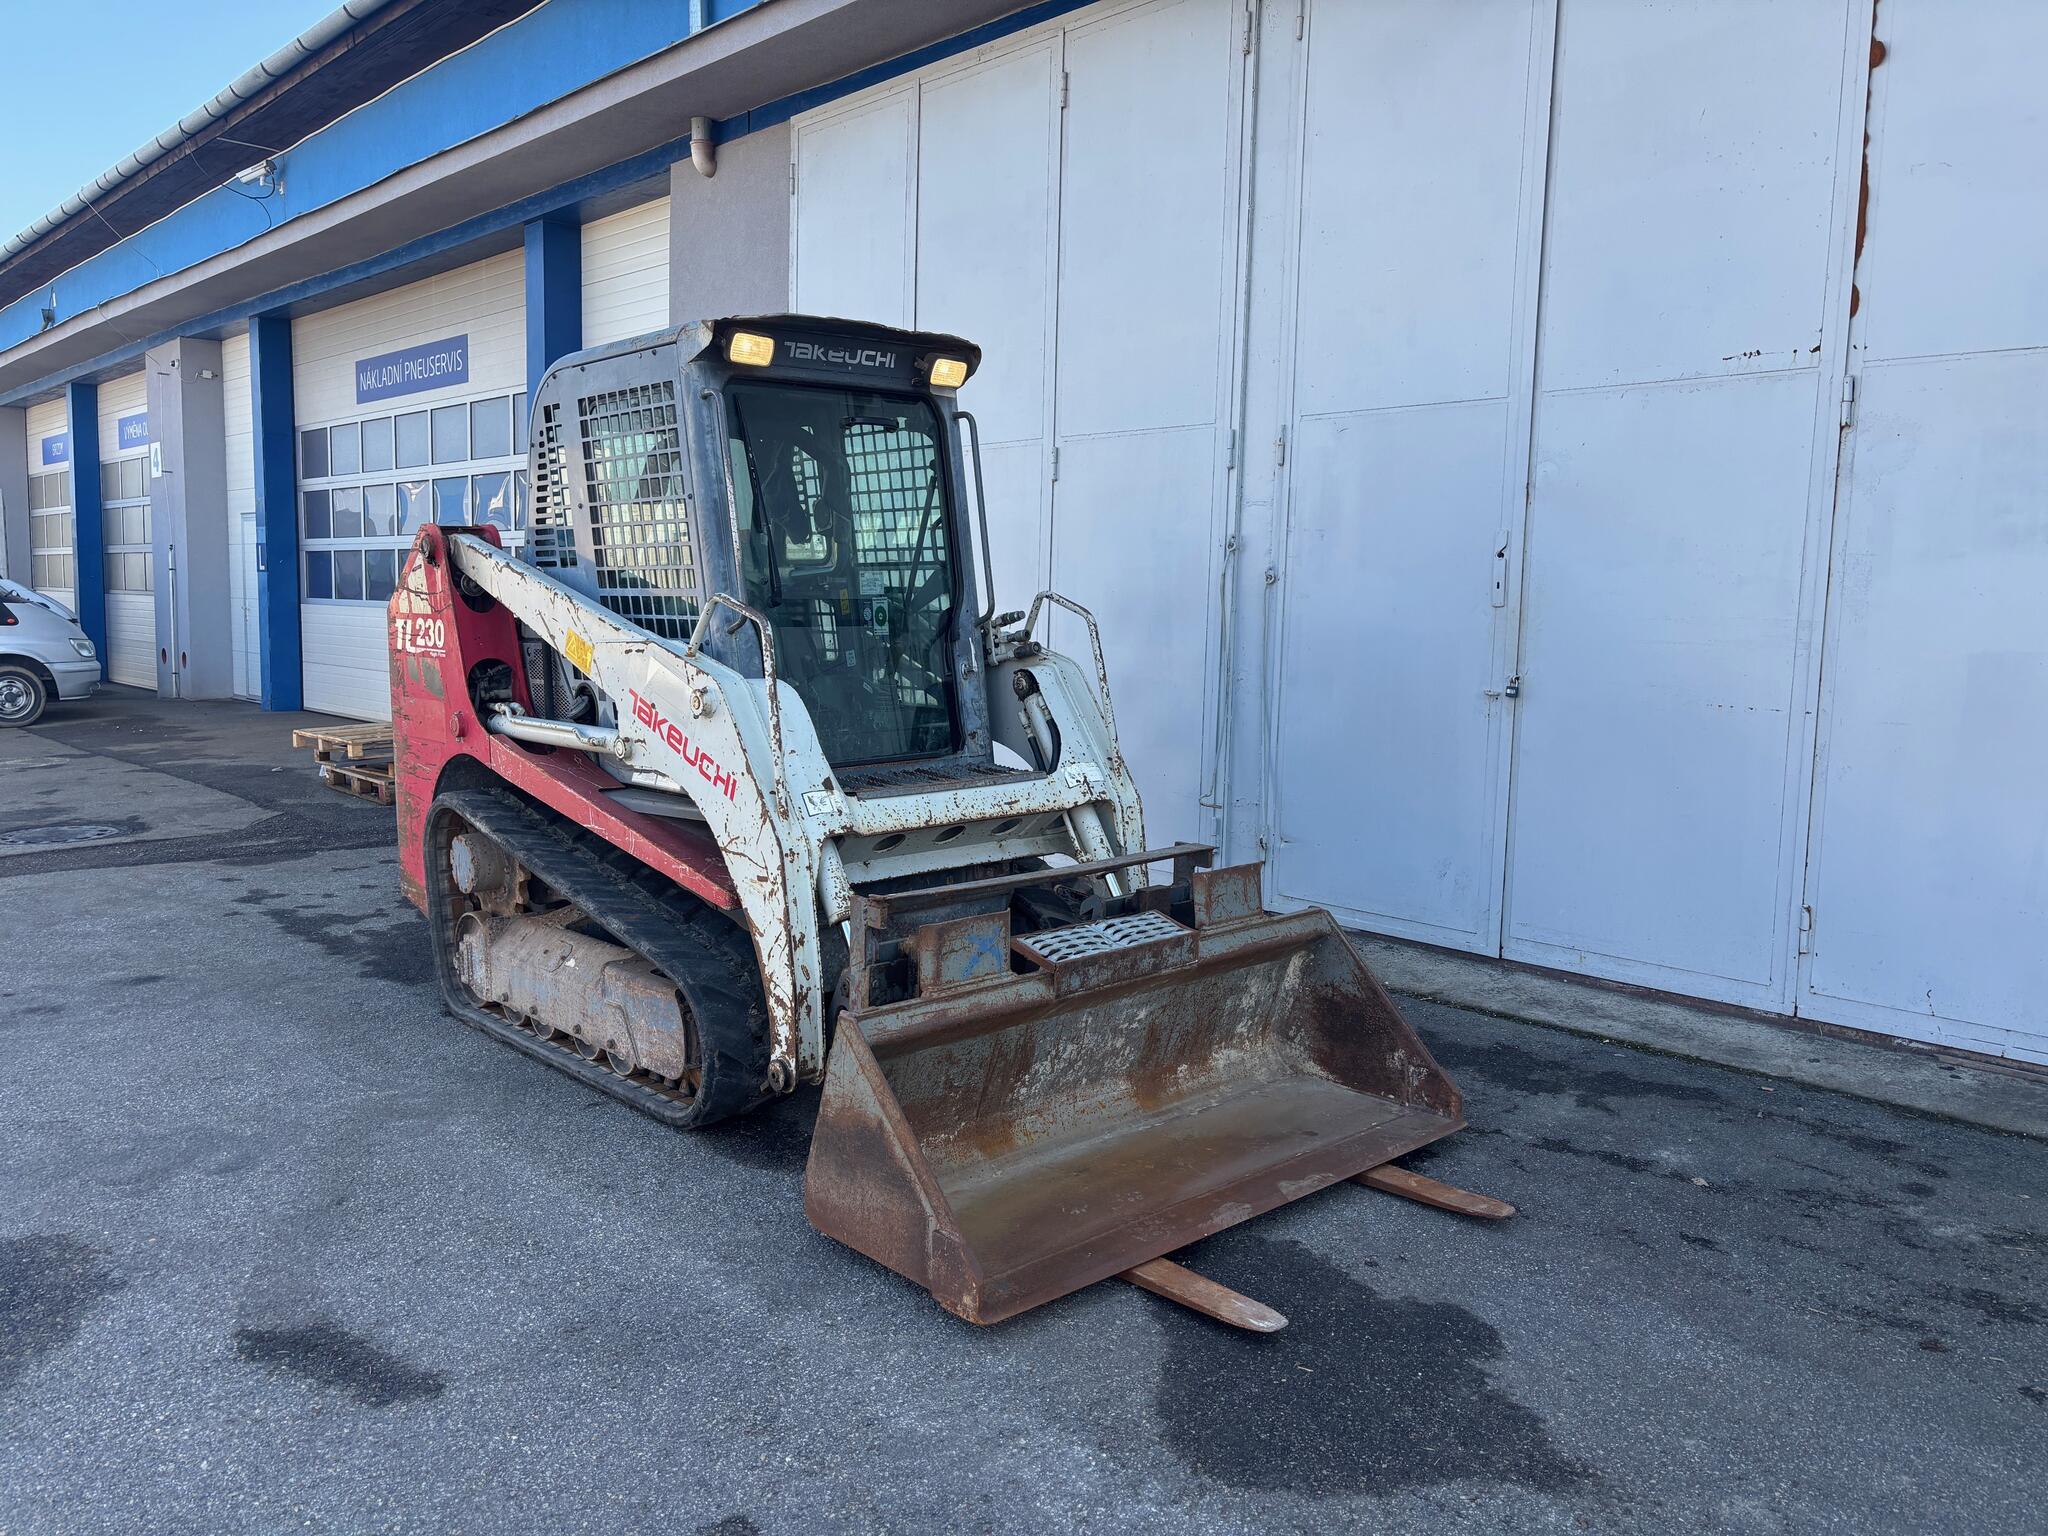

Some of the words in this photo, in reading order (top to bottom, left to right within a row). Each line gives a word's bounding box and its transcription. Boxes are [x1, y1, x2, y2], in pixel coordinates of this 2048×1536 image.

[360, 358, 403, 391] NÁKLADNÍ
[404, 350, 463, 382] PNEUSERVIS
[123, 421, 142, 440] VÝMĚNA
[152, 447, 160, 473] 4
